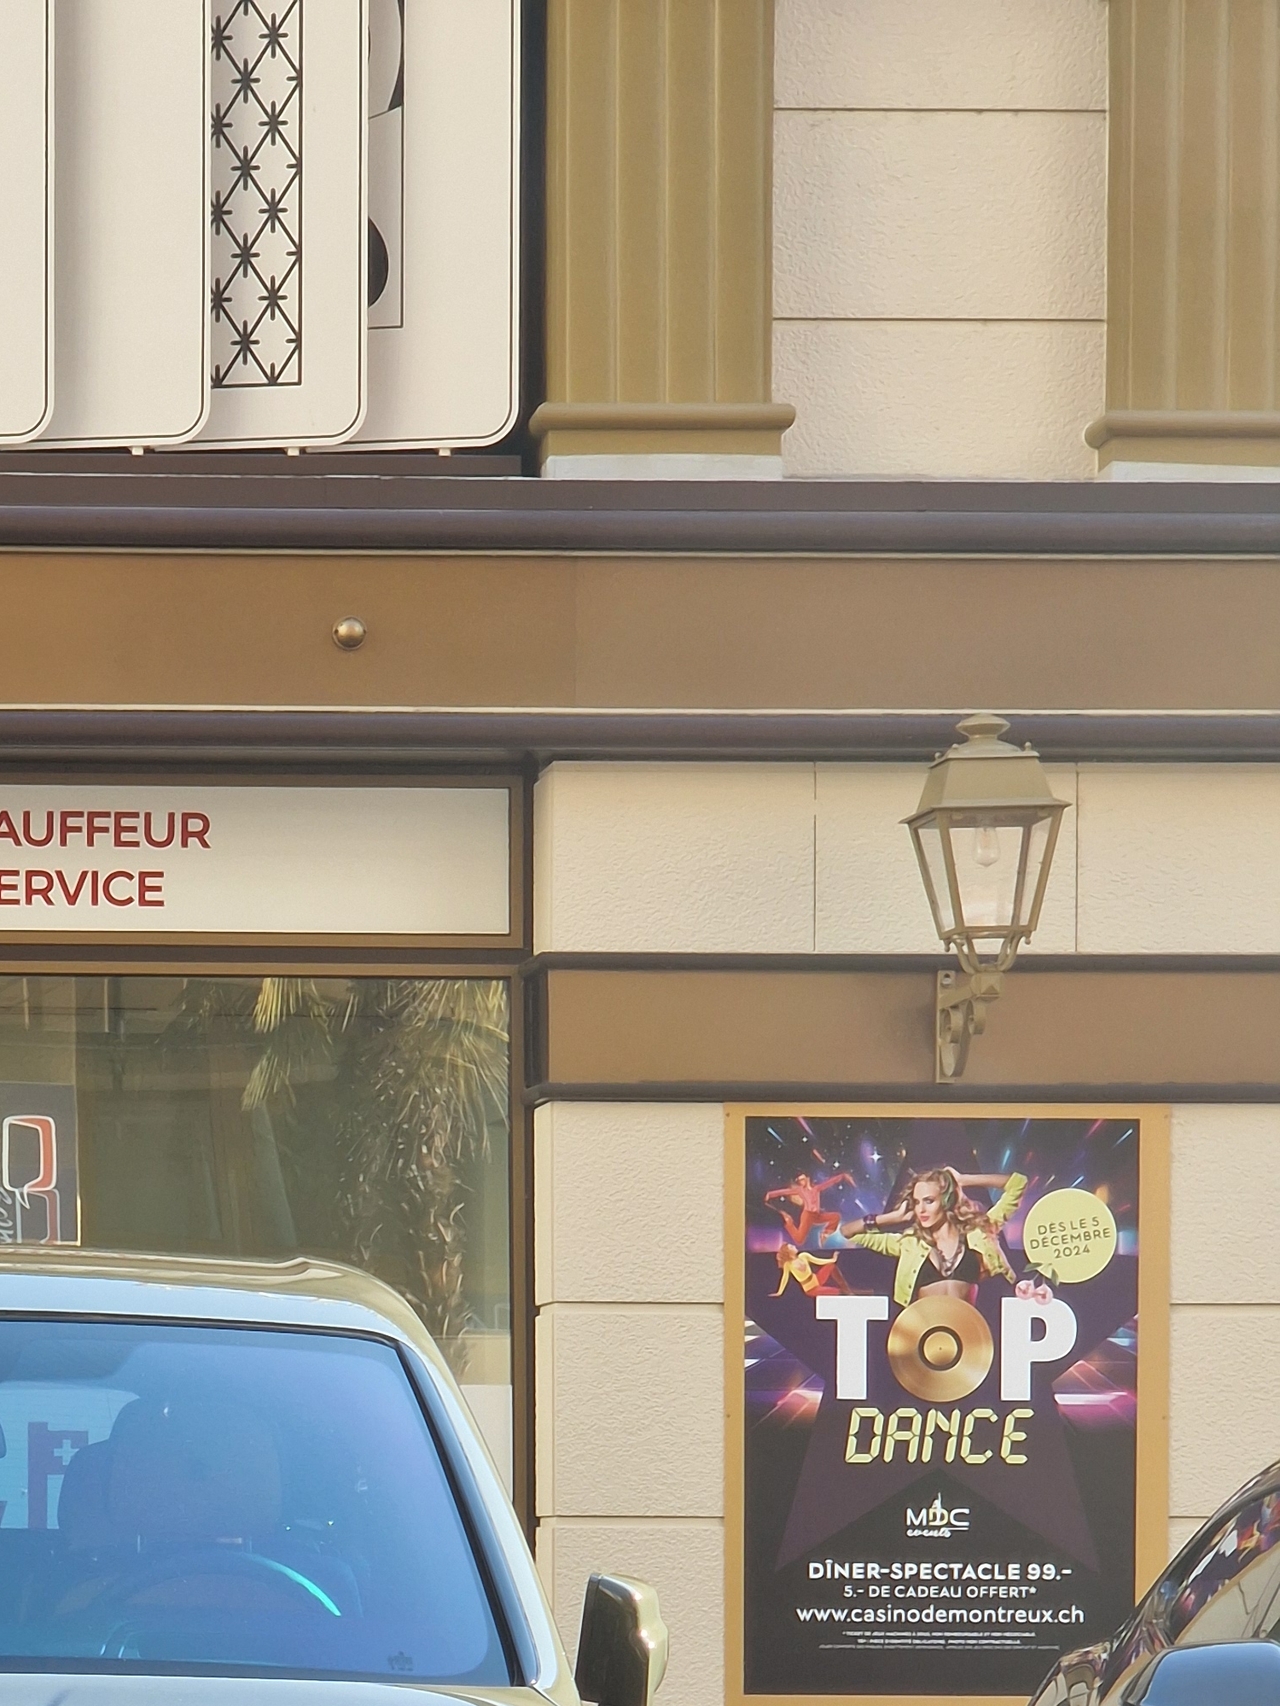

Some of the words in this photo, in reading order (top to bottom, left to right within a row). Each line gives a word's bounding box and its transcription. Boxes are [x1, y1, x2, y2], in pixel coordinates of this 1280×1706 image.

[1070, 1218, 1087, 1230] LE
[1092, 1216, 1100, 1227] 5
[1053, 1244, 1091, 1259] 2024
[816, 1295, 1078, 1403] TOP
[844, 1407, 1035, 1465] DANCE
[808, 1559, 1022, 1580] DÎNER-SPECTACLE
[868, 1585, 890, 1598] DE
[894, 1585, 962, 1598] CADEAU
[796, 1604, 1085, 1624] www.casinodemontreux.ch
